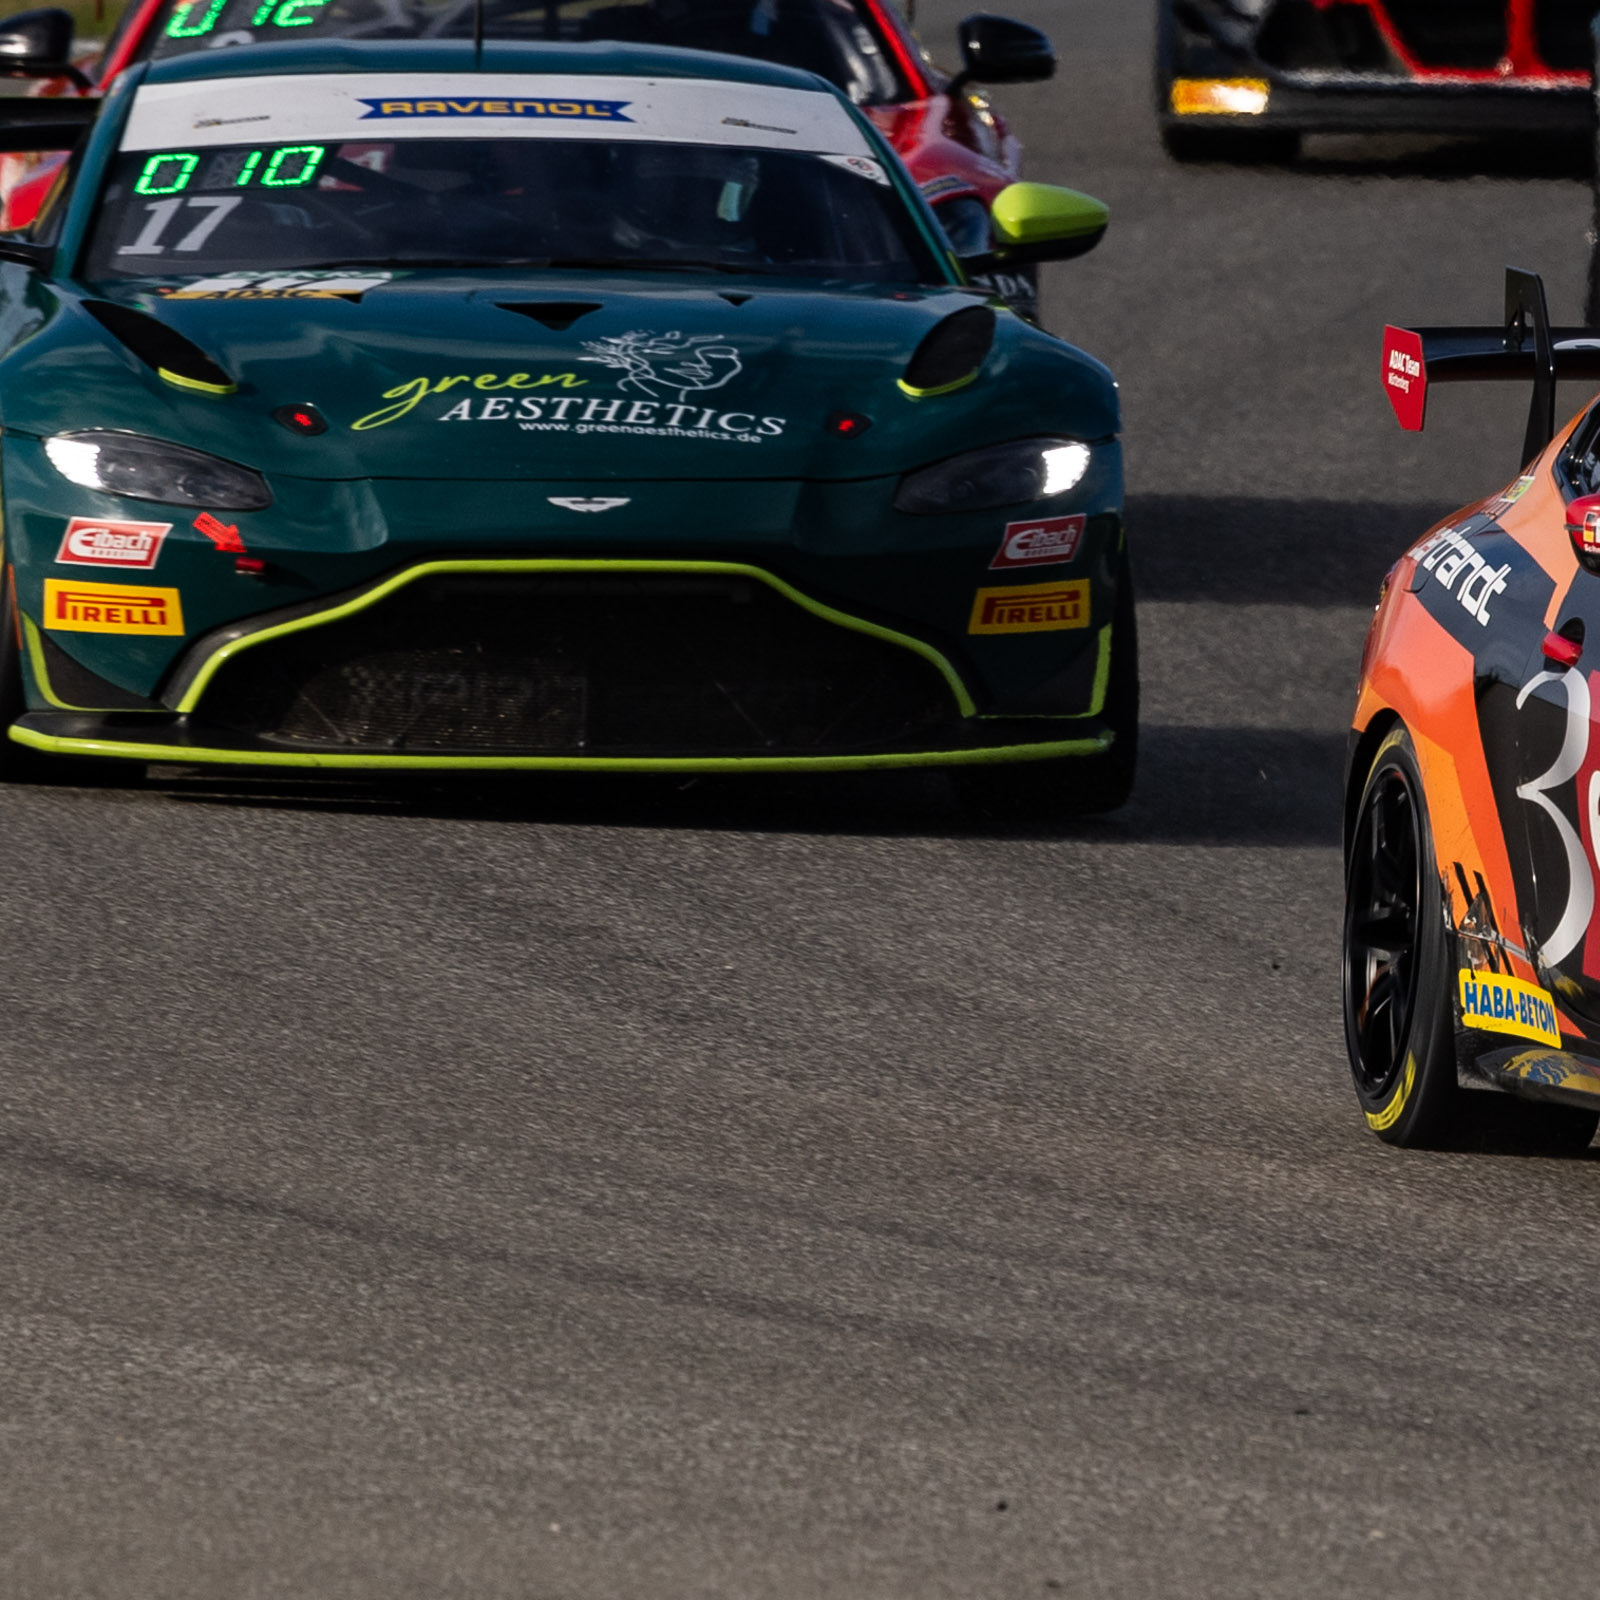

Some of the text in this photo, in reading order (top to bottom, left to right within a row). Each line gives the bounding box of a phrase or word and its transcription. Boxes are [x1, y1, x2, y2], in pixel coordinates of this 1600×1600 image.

[380, 99, 612, 119] RAVENOL
[133, 145, 326, 196] 010
[117, 195, 244, 256] 17
[350, 371, 590, 432] green
[437, 396, 788, 437] AESTHETICS
[518, 421, 763, 444] www.greenaesthetics.de
[68, 527, 153, 561] Eibach
[1003, 524, 1078, 560] Eibach
[56, 590, 167, 626] PIRELLI
[980, 589, 1082, 625] PIRELLI
[1462, 979, 1557, 1037] HABA-BETON
